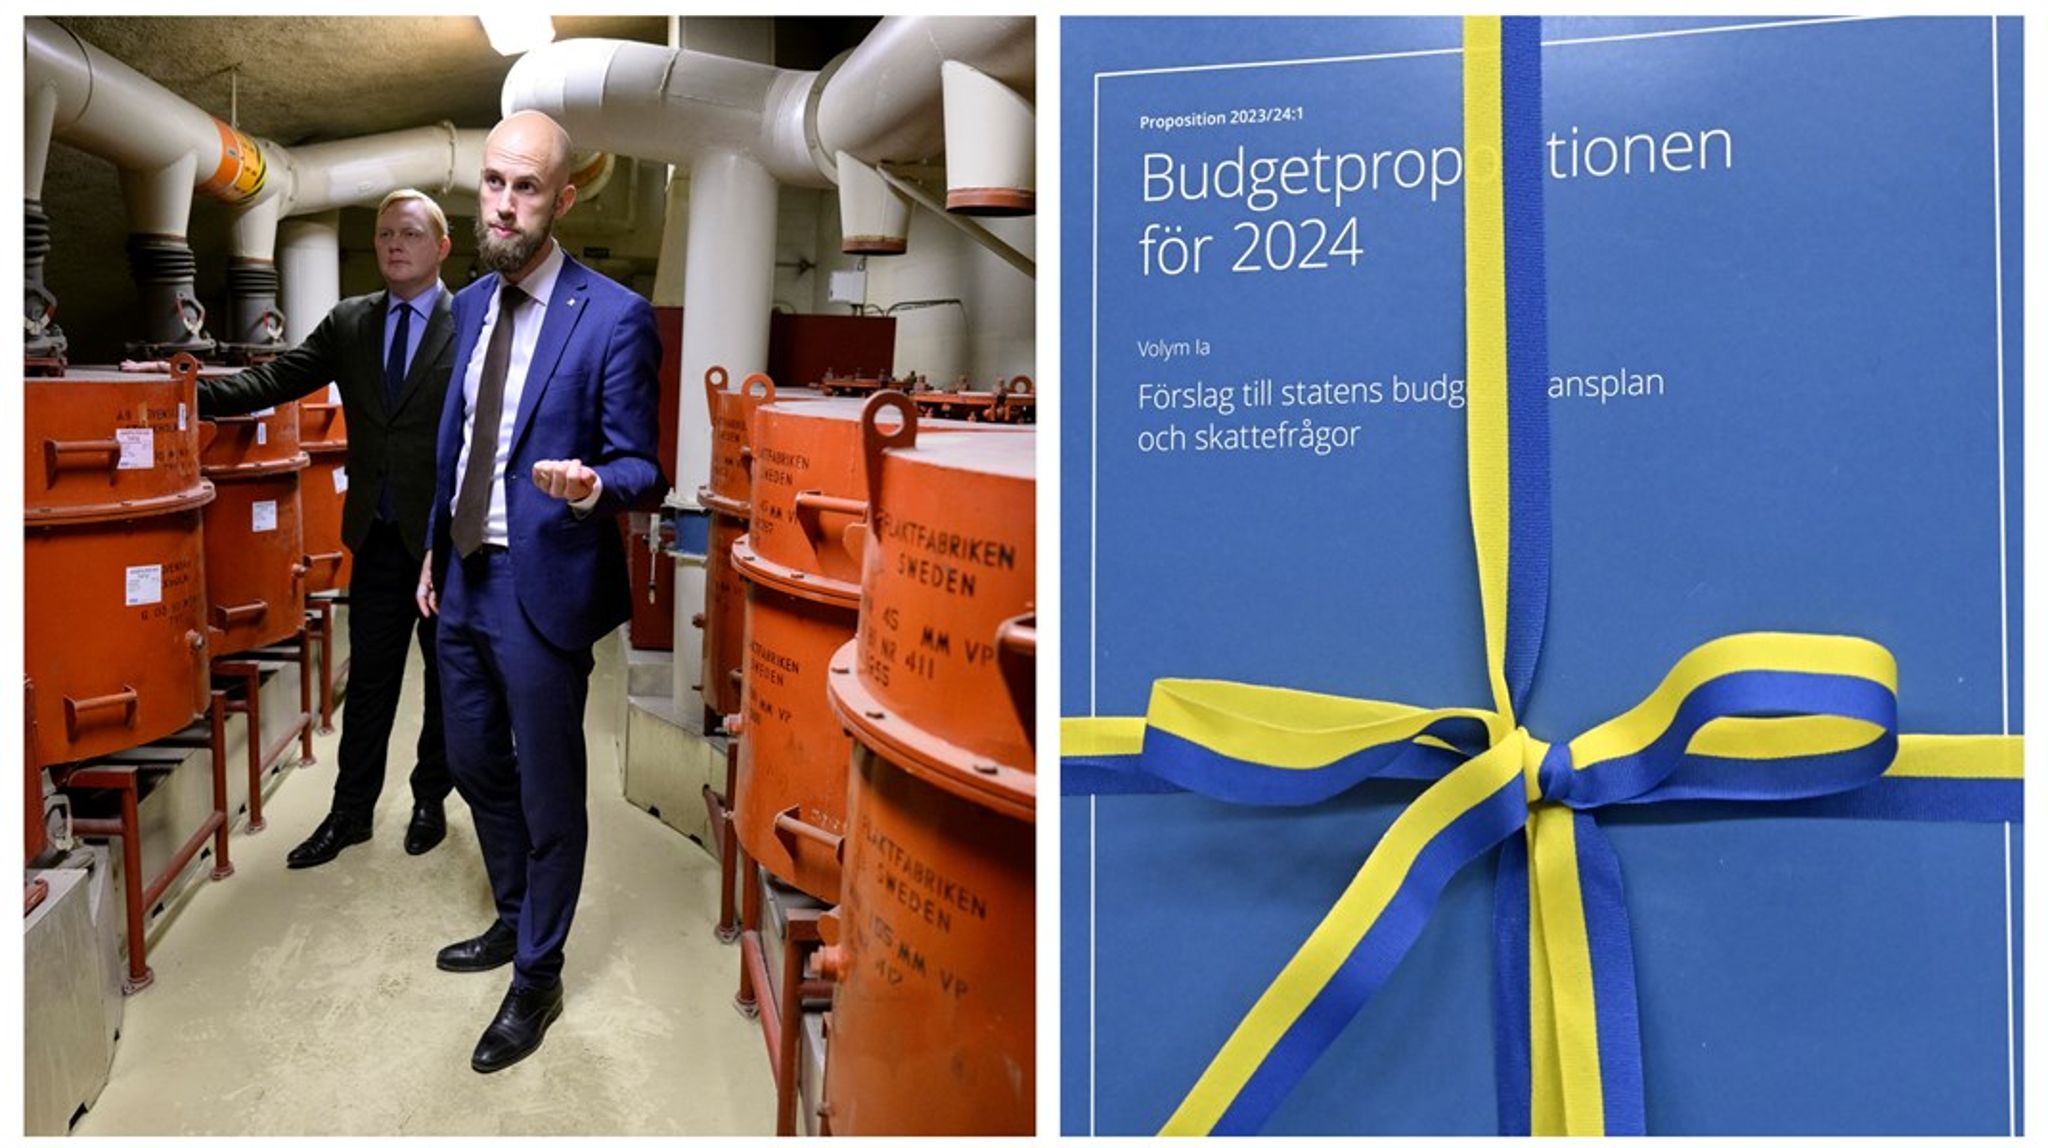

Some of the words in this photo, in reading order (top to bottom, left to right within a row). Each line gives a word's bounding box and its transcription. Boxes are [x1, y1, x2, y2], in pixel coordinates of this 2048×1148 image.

[1140, 112, 1226, 132] Proposition
[1230, 106, 1303, 124] 2023/24:1
[1138, 223, 1214, 276] för
[1232, 216, 1364, 272] 2024
[1137, 338, 1191, 362] Volym
[1139, 380, 1235, 416] Förslag
[1242, 378, 1272, 407] till
[1281, 378, 1383, 407] statens
[1392, 372, 1466, 409] budg
[1548, 367, 1664, 405] ansplan
[1137, 423, 1186, 452] och
[1195, 418, 1361, 456] skattefrågor
[898, 551, 977, 598] SWEDEN
[920, 625, 951, 657] MM
[964, 639, 996, 667] VP
